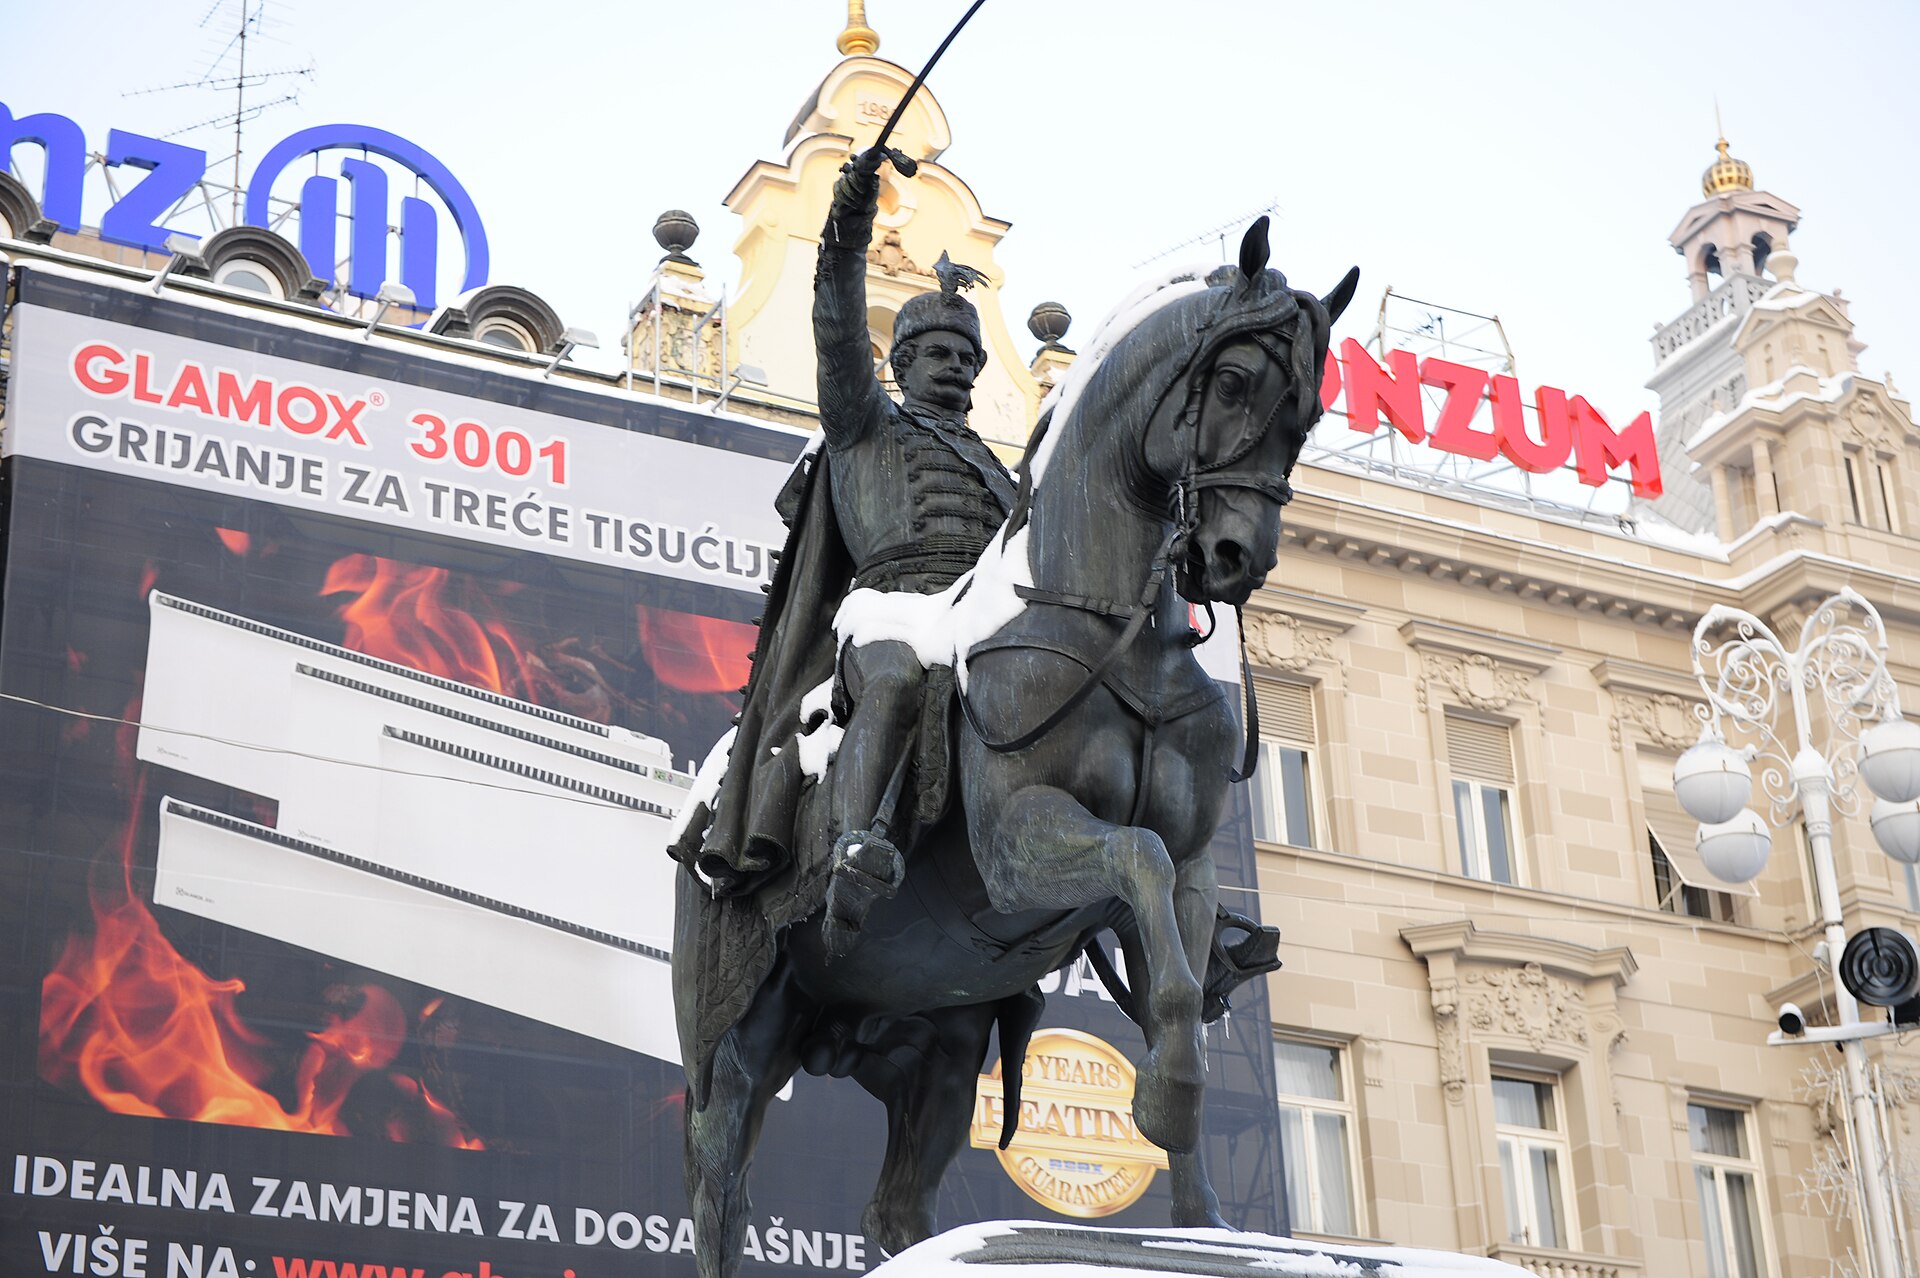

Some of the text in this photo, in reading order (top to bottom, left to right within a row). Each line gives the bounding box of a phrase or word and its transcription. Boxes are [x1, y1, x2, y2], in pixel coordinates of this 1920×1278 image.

[410, 413, 565, 485] 3001
[1320, 337, 1663, 499] NZUM
[72, 415, 324, 496] GRIJANJE
[342, 466, 409, 512] ZA
[425, 481, 568, 543] TREĆE
[1037, 1055, 1121, 1090] YEARS
[981, 1094, 1154, 1147] HEATIN
[1019, 1156, 1136, 1205] GUARANTEE
[13, 1154, 866, 1271] IDEALNA ZAMJENA ZA DOSAAŠNJE
[38, 1224, 148, 1278] VIŠE
